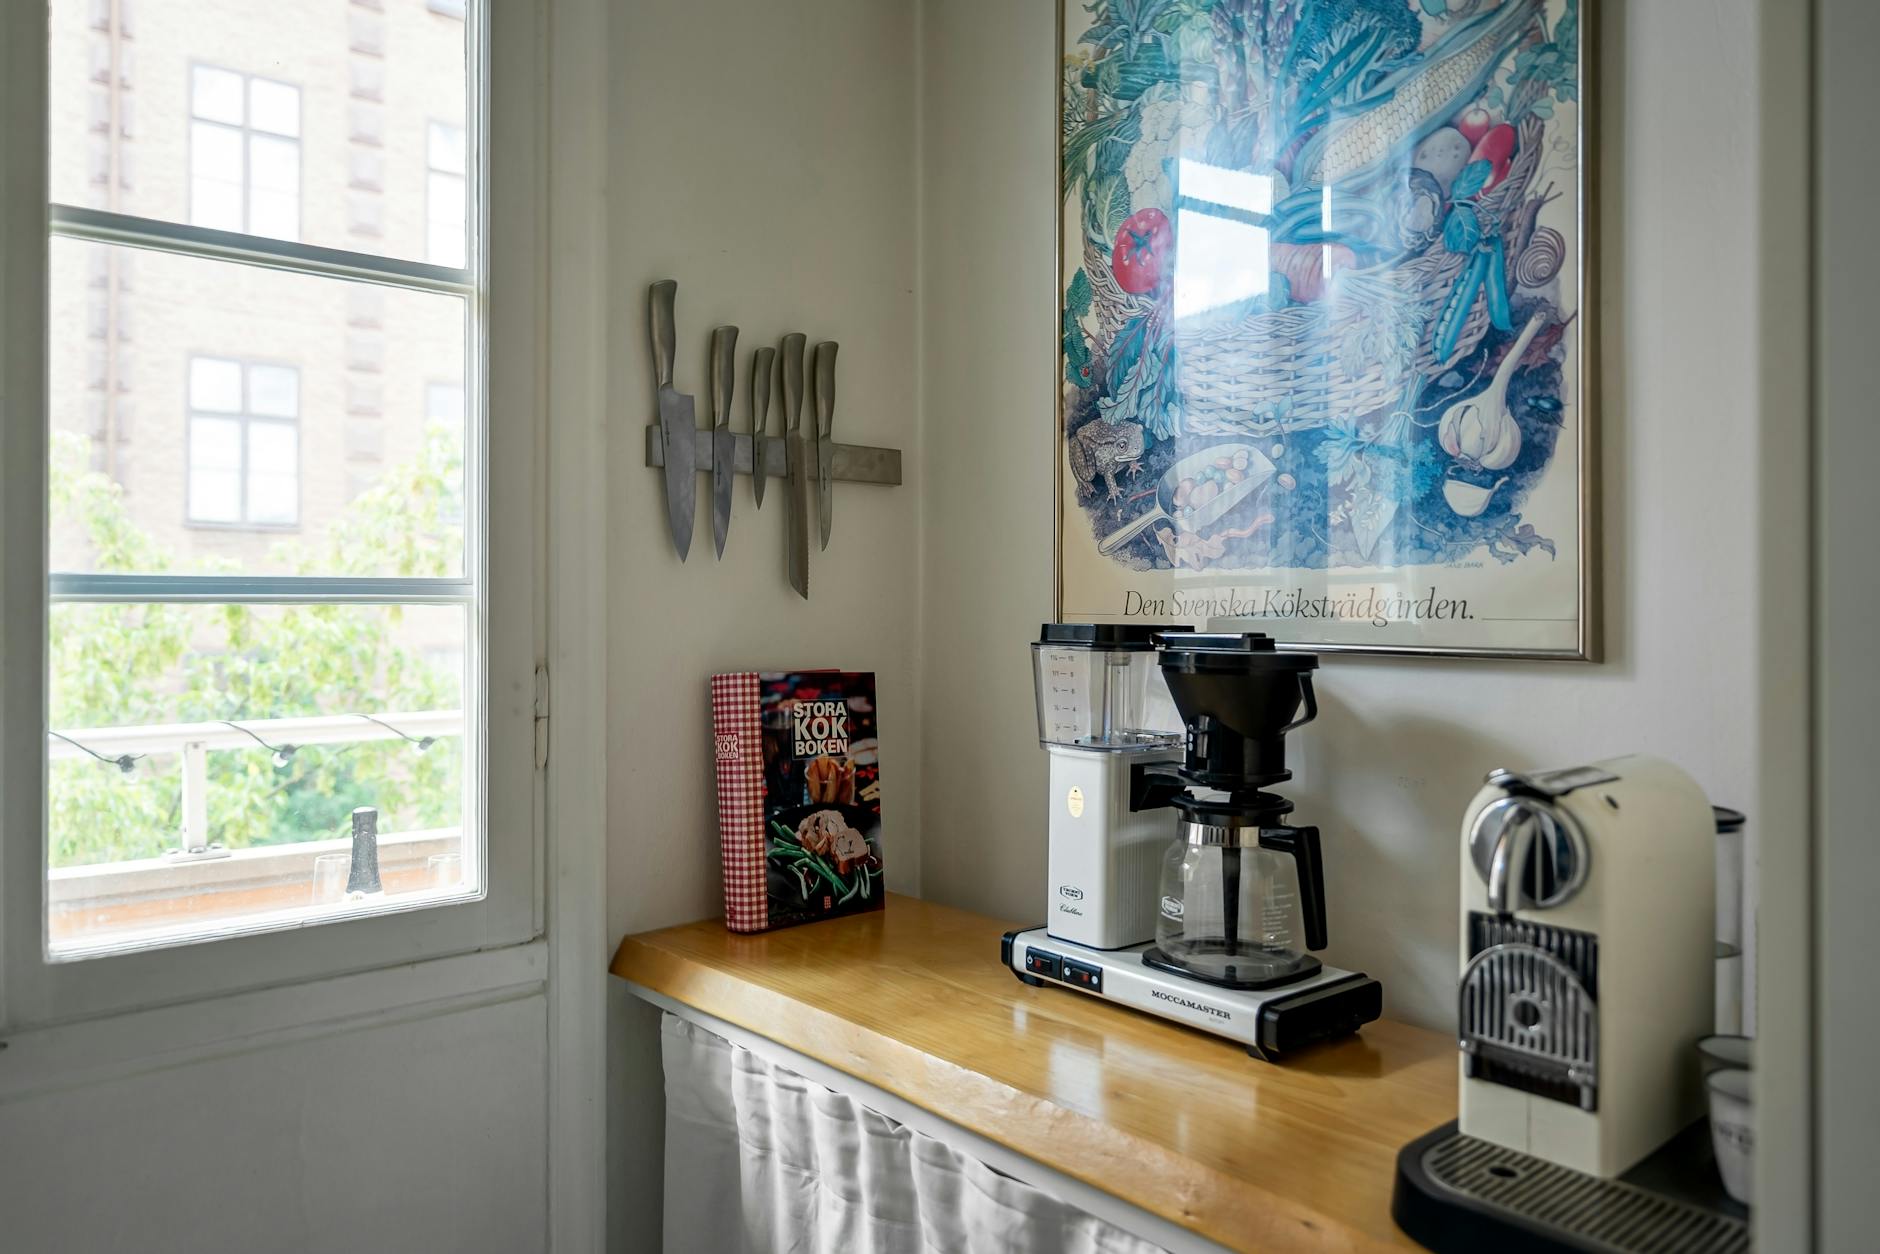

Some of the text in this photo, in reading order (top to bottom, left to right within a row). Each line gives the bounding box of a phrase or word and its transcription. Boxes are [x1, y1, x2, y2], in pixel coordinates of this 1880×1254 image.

[1123, 586, 1474, 628] Den Svenska Köksträdgården.
[793, 701, 847, 718] STORA
[794, 716, 848, 741] KOK
[716, 734, 738, 742] STORA
[717, 741, 738, 752] KOK
[795, 738, 848, 756] BOKEN
[1151, 990, 1232, 1020] MOCCAMASTER
